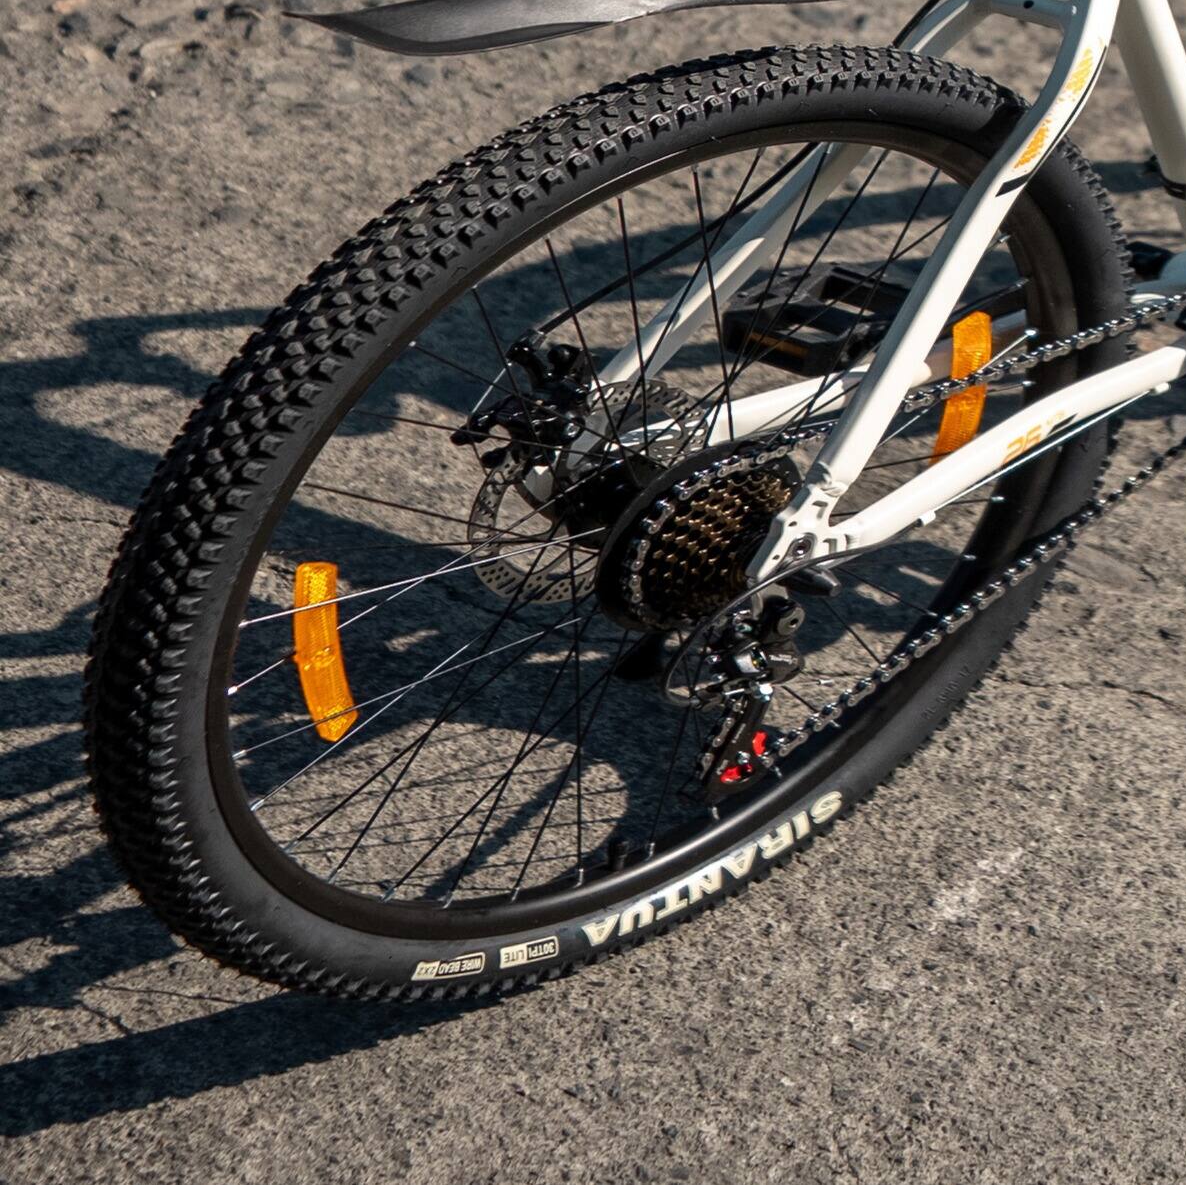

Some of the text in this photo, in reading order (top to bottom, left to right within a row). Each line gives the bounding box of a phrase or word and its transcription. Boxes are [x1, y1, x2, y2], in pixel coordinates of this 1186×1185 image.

[581, 790, 843, 947] SIRANTUA
[503, 941, 555, 964] 30TPI LITE
[438, 960, 460, 975] BEAD
[460, 956, 482, 972] WIRE
